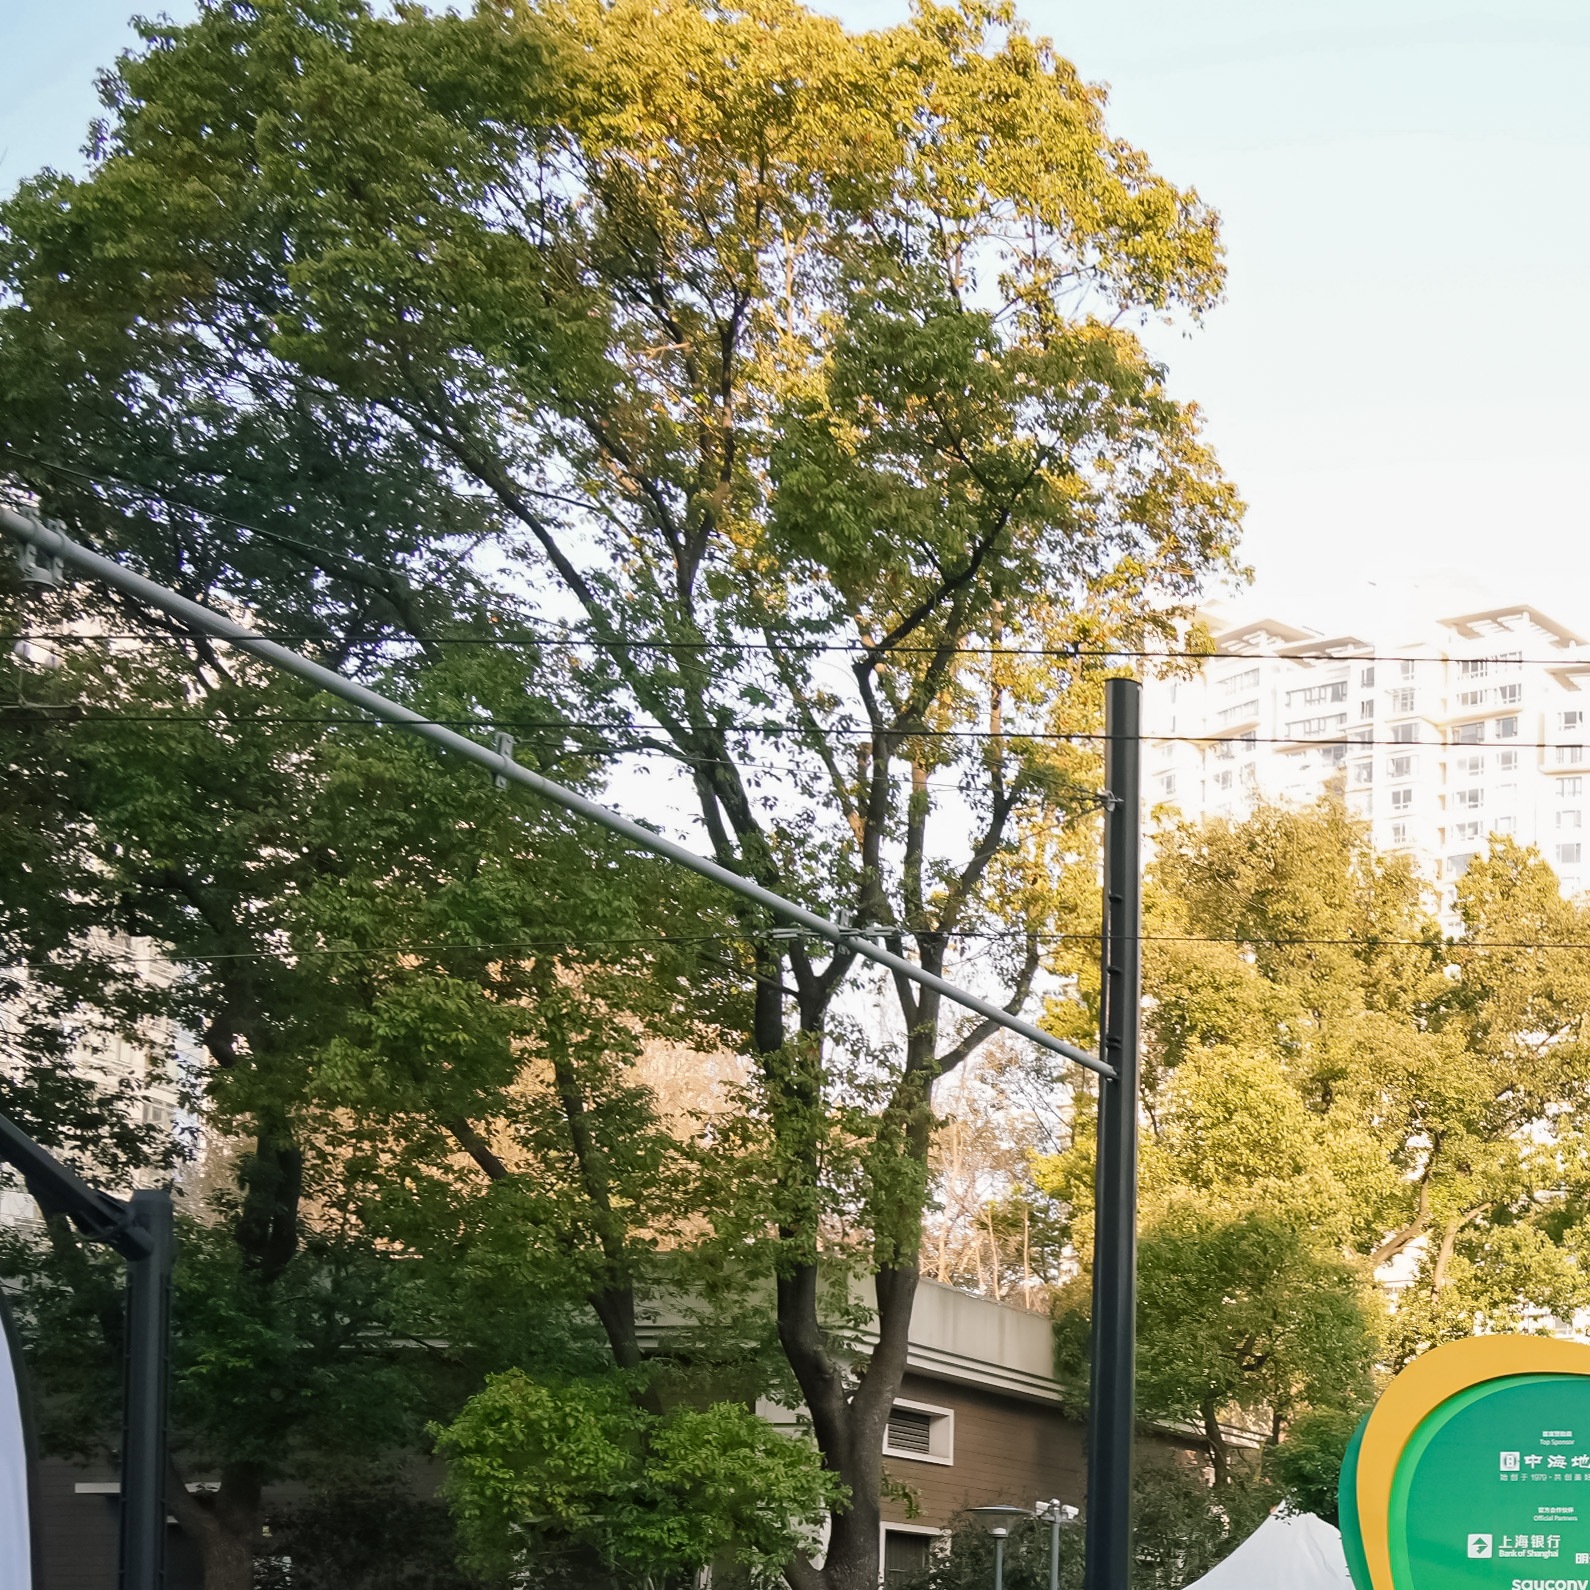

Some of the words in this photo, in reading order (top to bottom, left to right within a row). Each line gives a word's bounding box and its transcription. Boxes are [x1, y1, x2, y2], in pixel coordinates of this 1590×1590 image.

[1499, 1535, 1561, 1549] 上海银行
[1527, 1550, 1559, 1559] Shanghai
